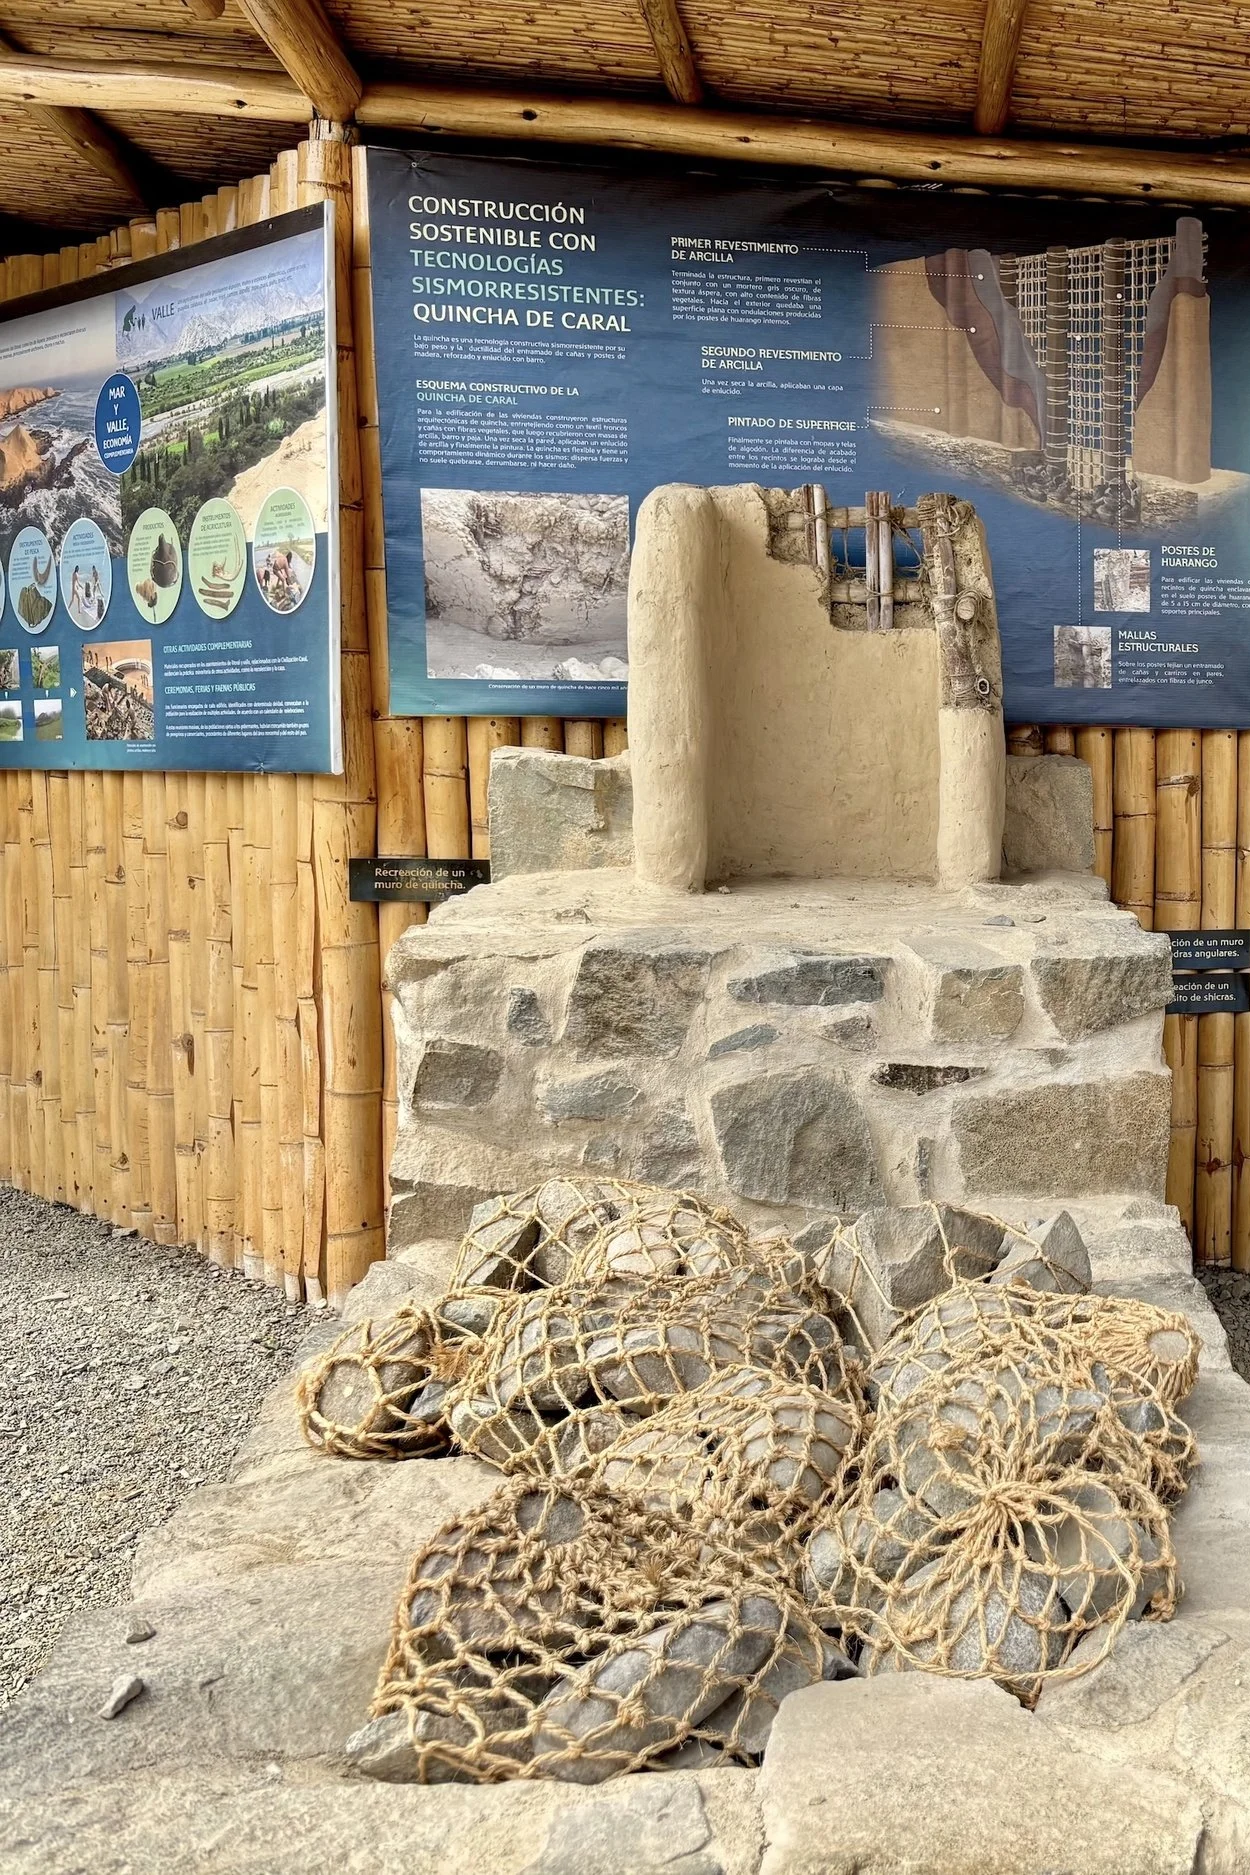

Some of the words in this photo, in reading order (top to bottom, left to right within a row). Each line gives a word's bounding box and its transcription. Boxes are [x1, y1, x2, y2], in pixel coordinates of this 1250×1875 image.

[409, 197, 584, 223] CONSTRUCCIÓN
[410, 224, 541, 247] SOSTENIBLE
[549, 233, 595, 251] CON
[671, 238, 711, 248] PRIMER
[715, 240, 798, 254] REVESTIMIENTO
[672, 250, 686, 260] DE
[689, 252, 734, 262] ARCILLA
[410, 250, 563, 275] TECNOLOGÍAS
[412, 278, 644, 306] SISMORRESISTENTES:
[152, 302, 176, 320] VALLE
[414, 304, 519, 324] QUINCHA
[527, 310, 554, 327] DE
[562, 313, 631, 331] CARAL
[702, 346, 756, 357] SEGUNDO
[759, 349, 842, 361] REVESTIMIENTO
[702, 359, 716, 368] DE
[719, 360, 763, 370] ARCILLA
[416, 380, 467, 390] ESQUEMA
[469, 383, 547, 394] CONSTRUCTIVO
[551, 387, 564, 395] DE
[712, 387, 742, 395] enlucido.
[756, 380, 778, 390] arcilla,
[780, 381, 811, 391] aplicaban
[109, 386, 125, 400] MAR
[417, 392, 466, 402] QUINCHA
[469, 395, 482, 403] DE
[485, 396, 518, 405] CARAL
[114, 404, 118, 415] Y
[107, 419, 129, 433] VALLE,
[728, 417, 776, 427] PINTADO
[779, 419, 793, 428] DE
[796, 420, 856, 431] SUPERFICIE
[103, 434, 132, 449] ECONOMÍA
[1162, 546, 1200, 555] POSTES
[1202, 547, 1215, 556] DE
[1162, 558, 1218, 568] HUARANGO
[1119, 631, 1157, 640] MALLAS
[178, 644, 207, 652] ACTIVIDADES
[1119, 643, 1199, 652] ESTRUCTURALES
[165, 686, 195, 694] CEREMONIAS,
[233, 683, 256, 691] PÚBLICAS
[375, 868, 434, 878] Recreación
[435, 868, 449, 878] de
[374, 879, 402, 889] muro
[405, 879, 418, 888] de
[420, 880, 466, 890] quincha.
[1195, 950, 1239, 959] angulares.
